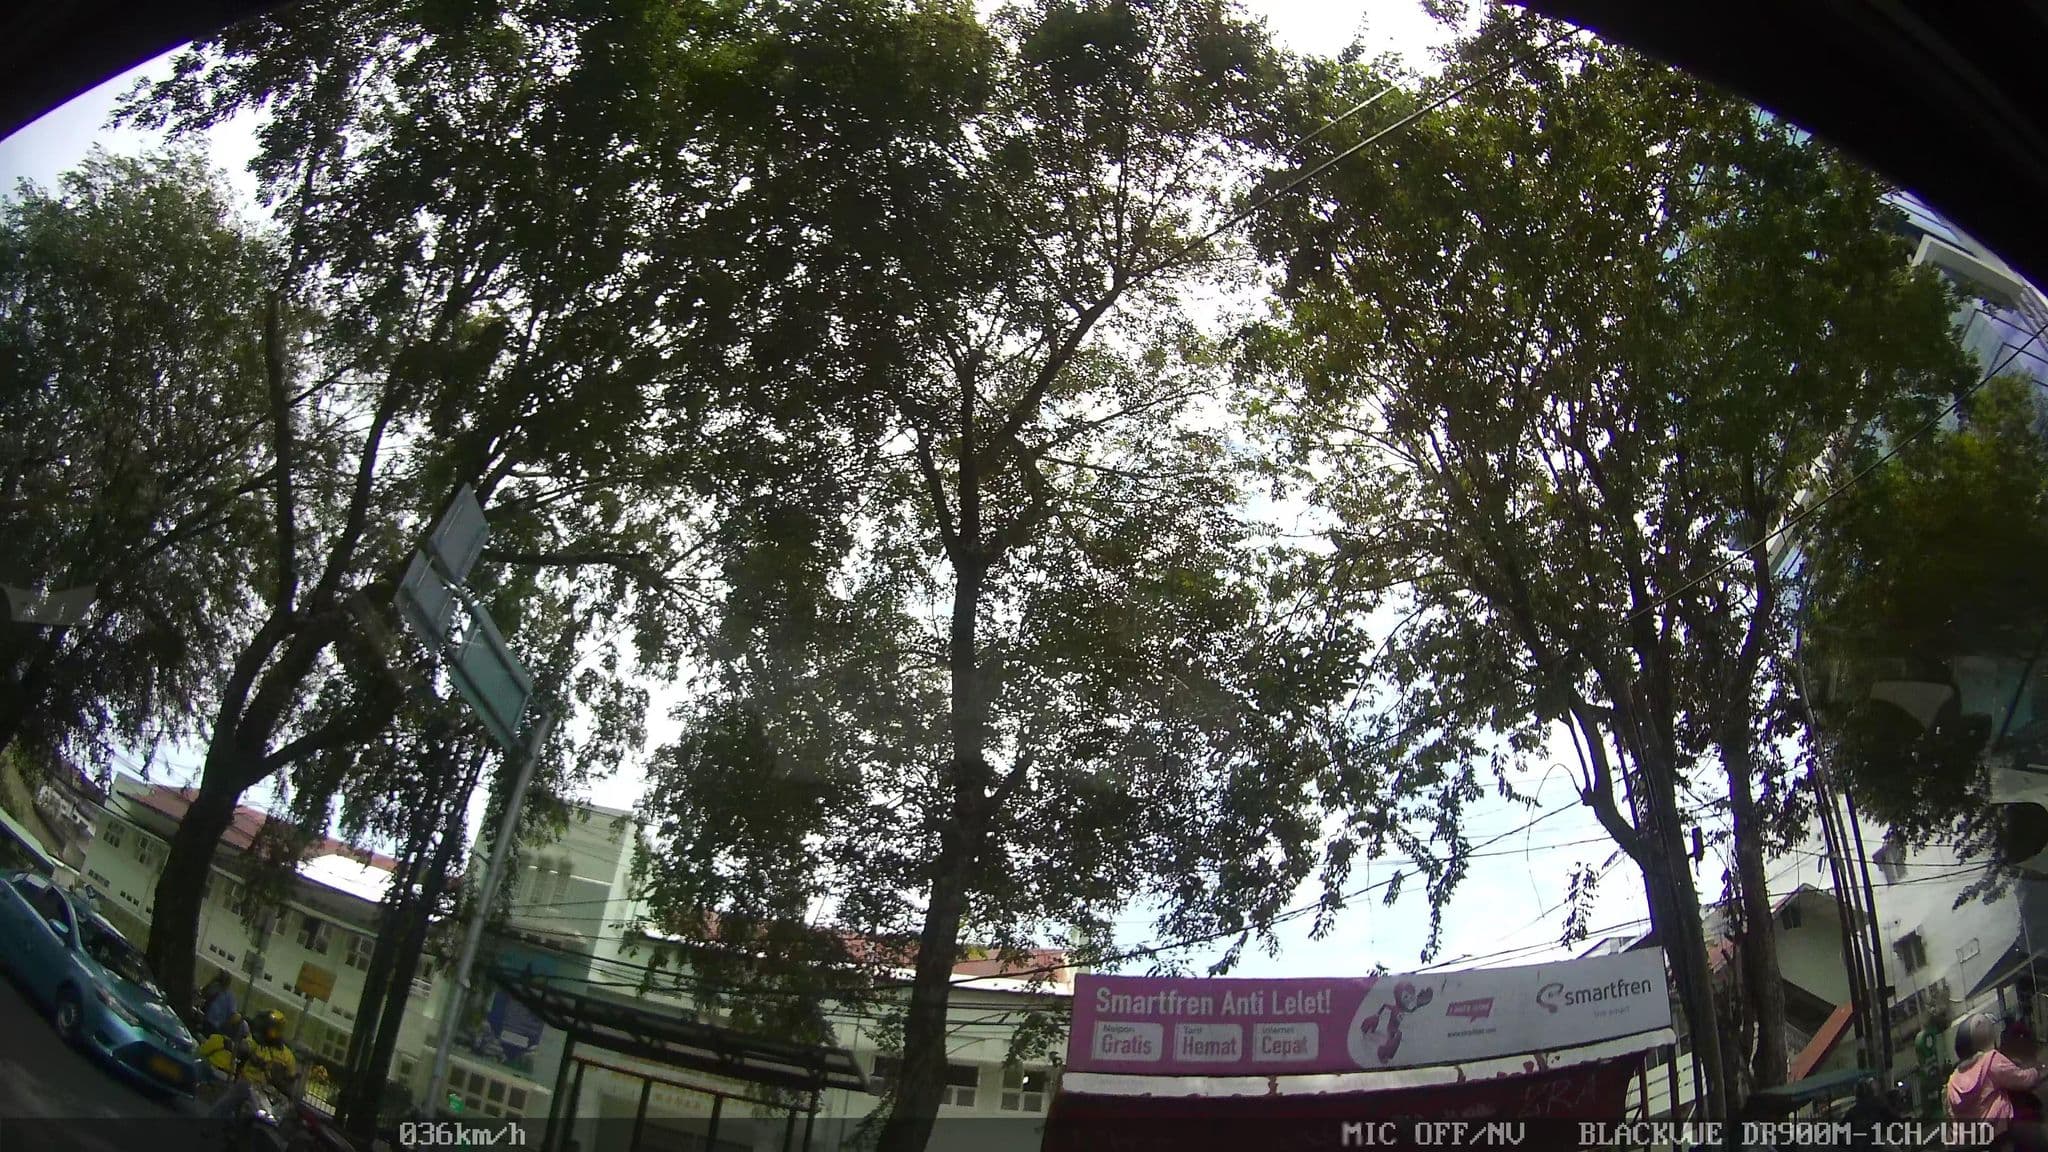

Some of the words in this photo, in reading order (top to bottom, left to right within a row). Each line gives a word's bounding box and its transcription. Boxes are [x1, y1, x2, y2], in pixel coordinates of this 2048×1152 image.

[1096, 986, 1213, 1015] Smartfren
[1221, 990, 1265, 1015] Anti
[1271, 988, 1332, 1015] Lelet!
[1564, 979, 1652, 1006] smartfren
[1102, 1034, 1153, 1054] Gratis
[1182, 1035, 1237, 1056] Hemat
[1261, 1036, 1309, 1056] Cepat
